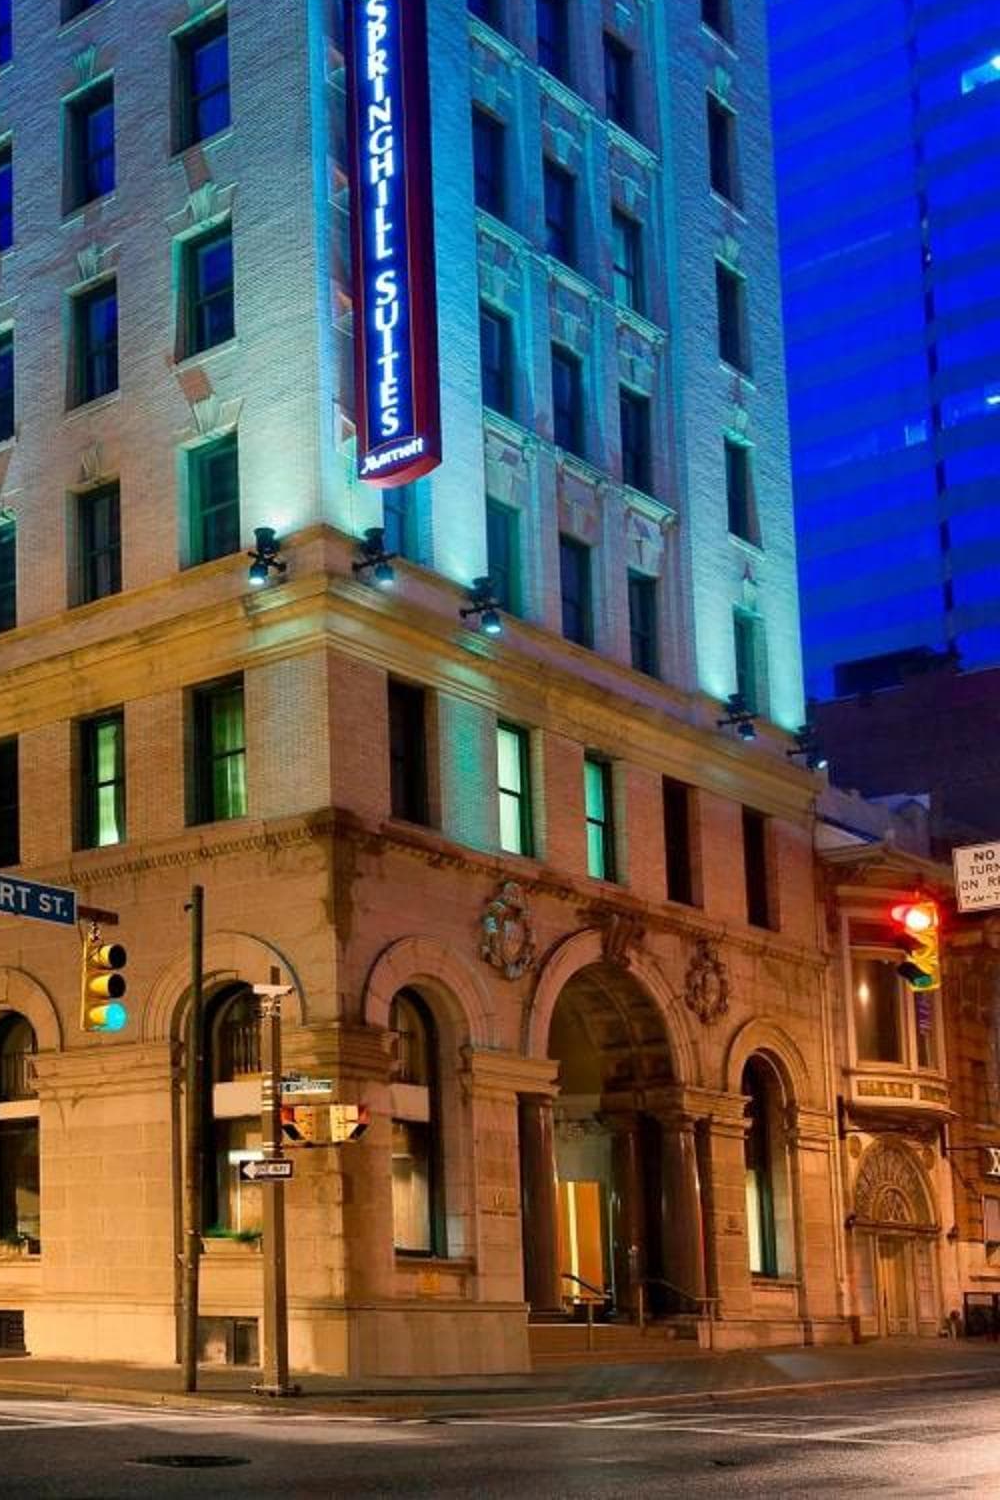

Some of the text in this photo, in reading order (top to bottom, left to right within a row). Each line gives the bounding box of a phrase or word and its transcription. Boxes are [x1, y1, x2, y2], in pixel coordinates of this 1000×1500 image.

[375, 270, 399, 437] SUITES
[360, 437, 424, 474] Marriott
[973, 850, 995, 862] NO
[961, 879, 978, 890] ON
[39, 893, 68, 916] ST.
